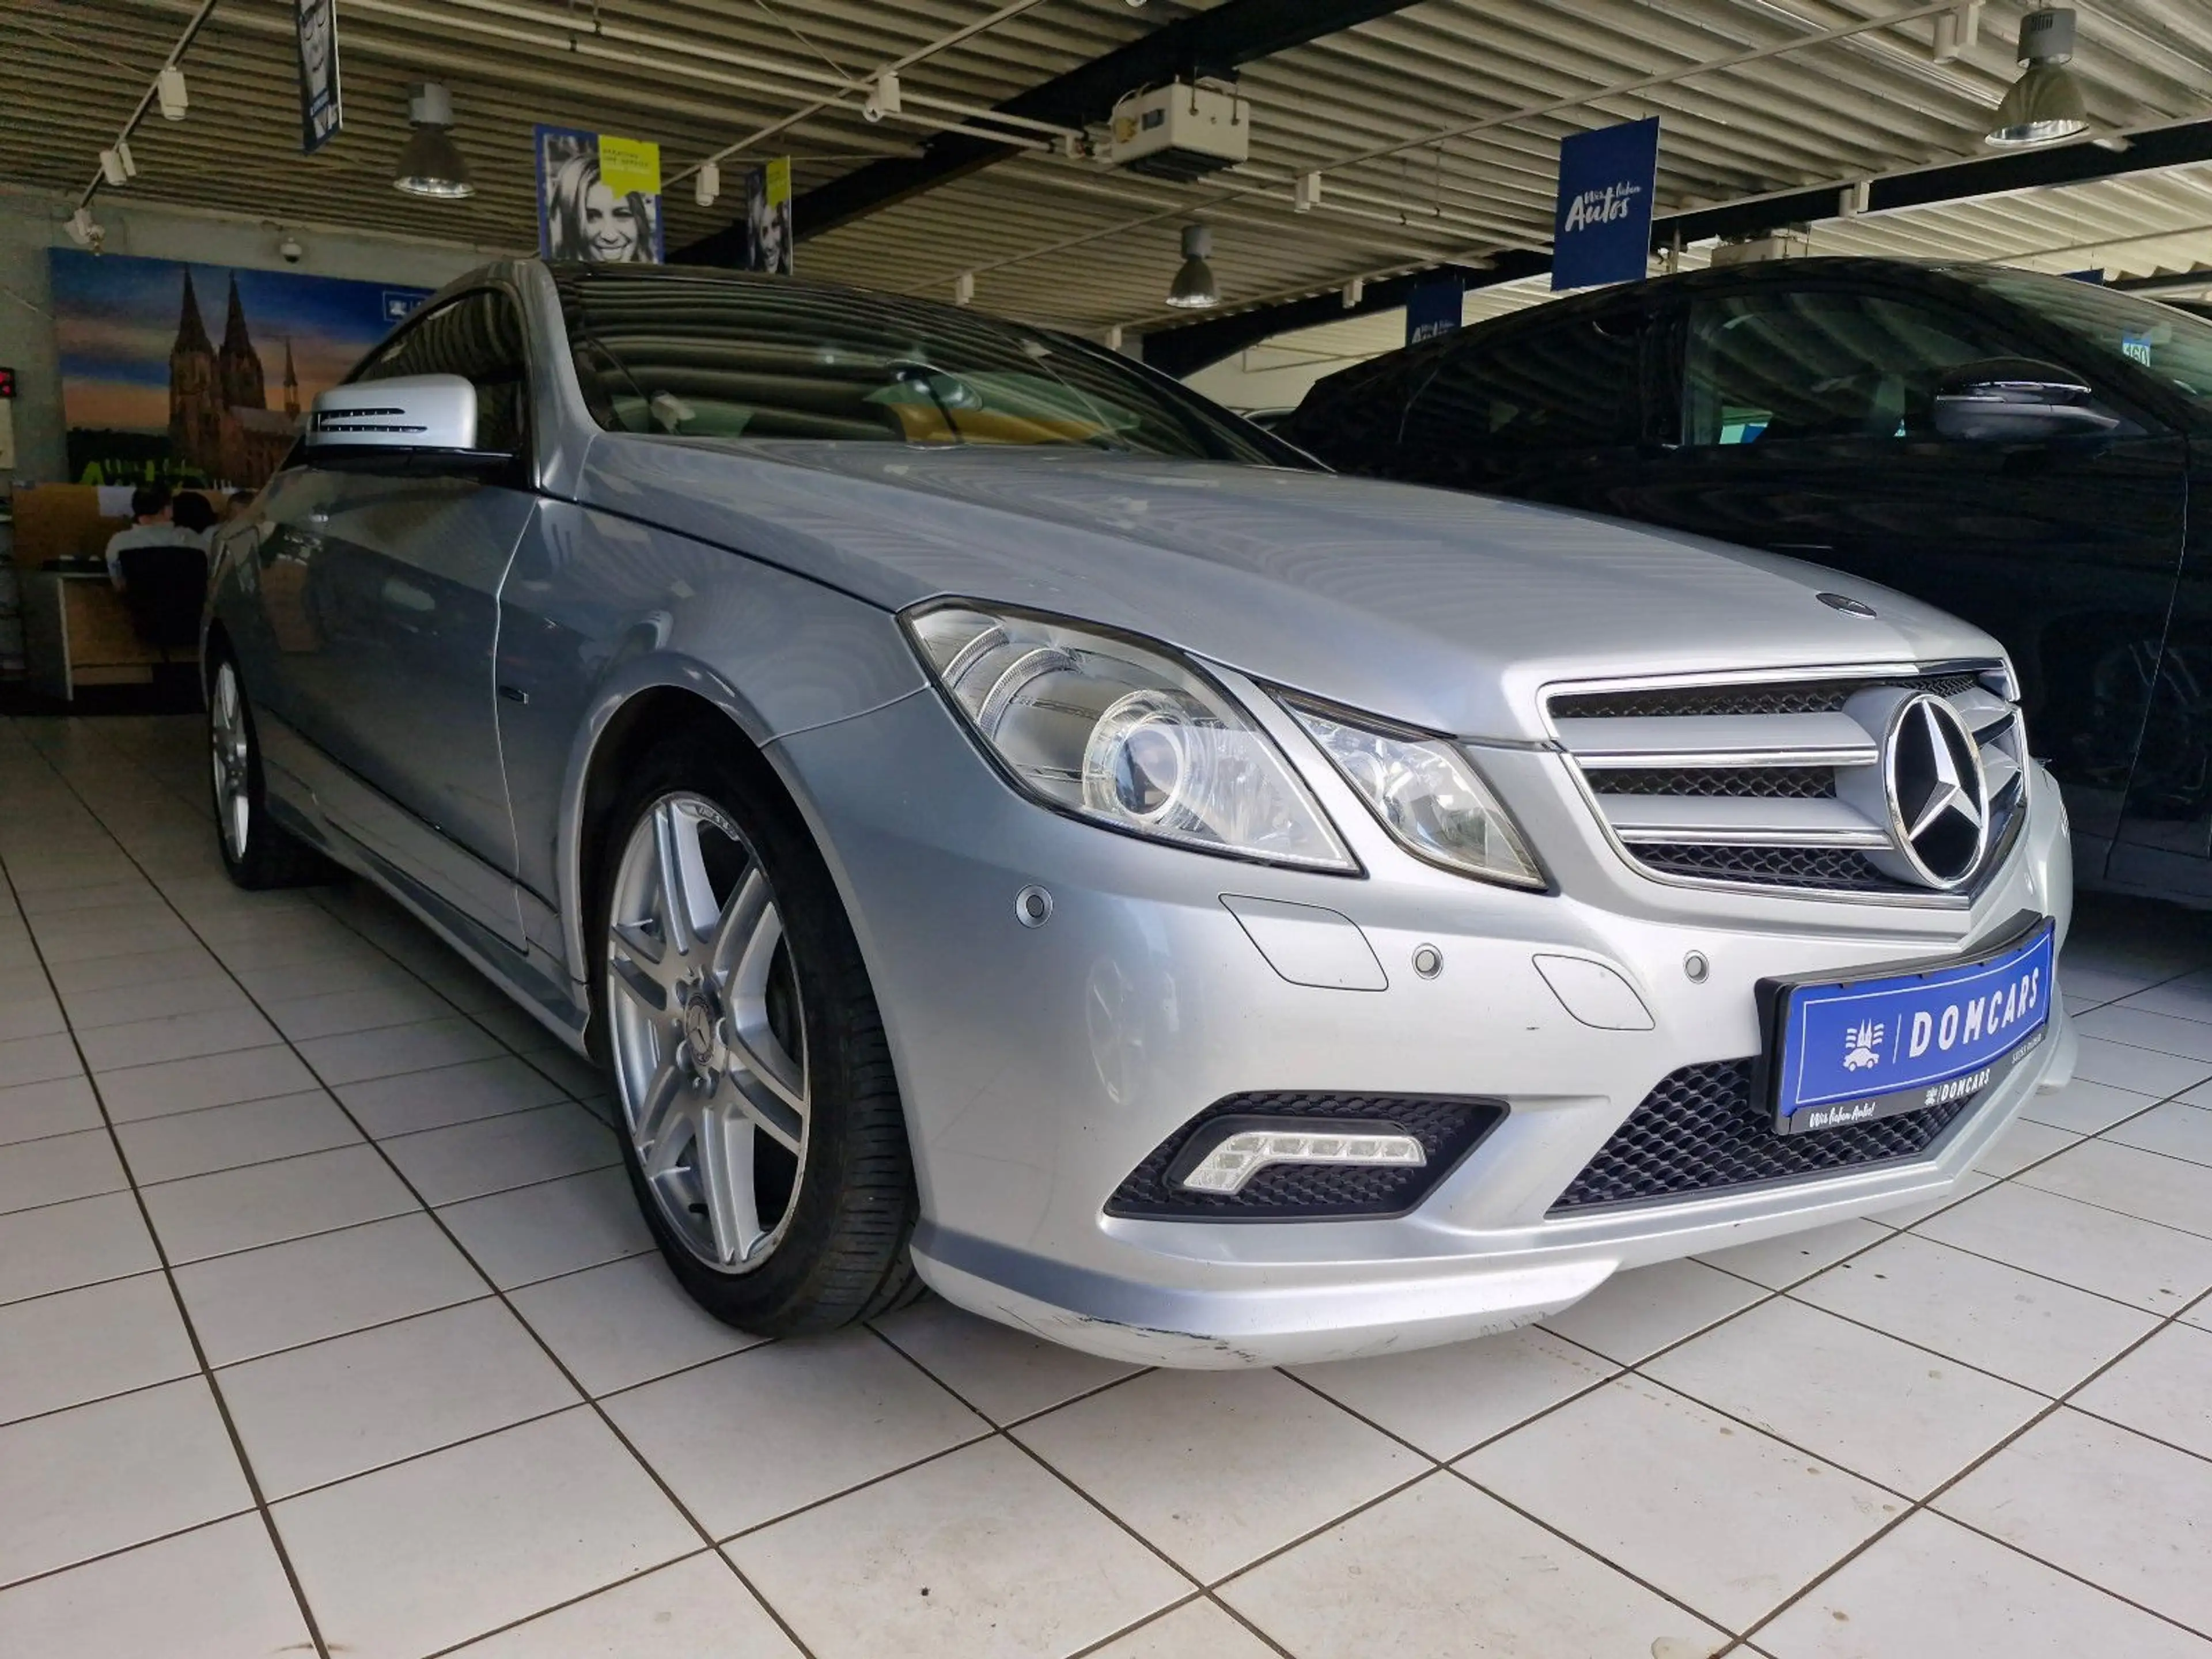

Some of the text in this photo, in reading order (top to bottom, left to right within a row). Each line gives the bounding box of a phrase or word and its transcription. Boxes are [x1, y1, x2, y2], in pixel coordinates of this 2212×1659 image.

[1565, 187, 1631, 232] Autos
[1909, 967, 2039, 1058] DOMCARS
[1941, 1069, 1990, 1101] DOMCARS
